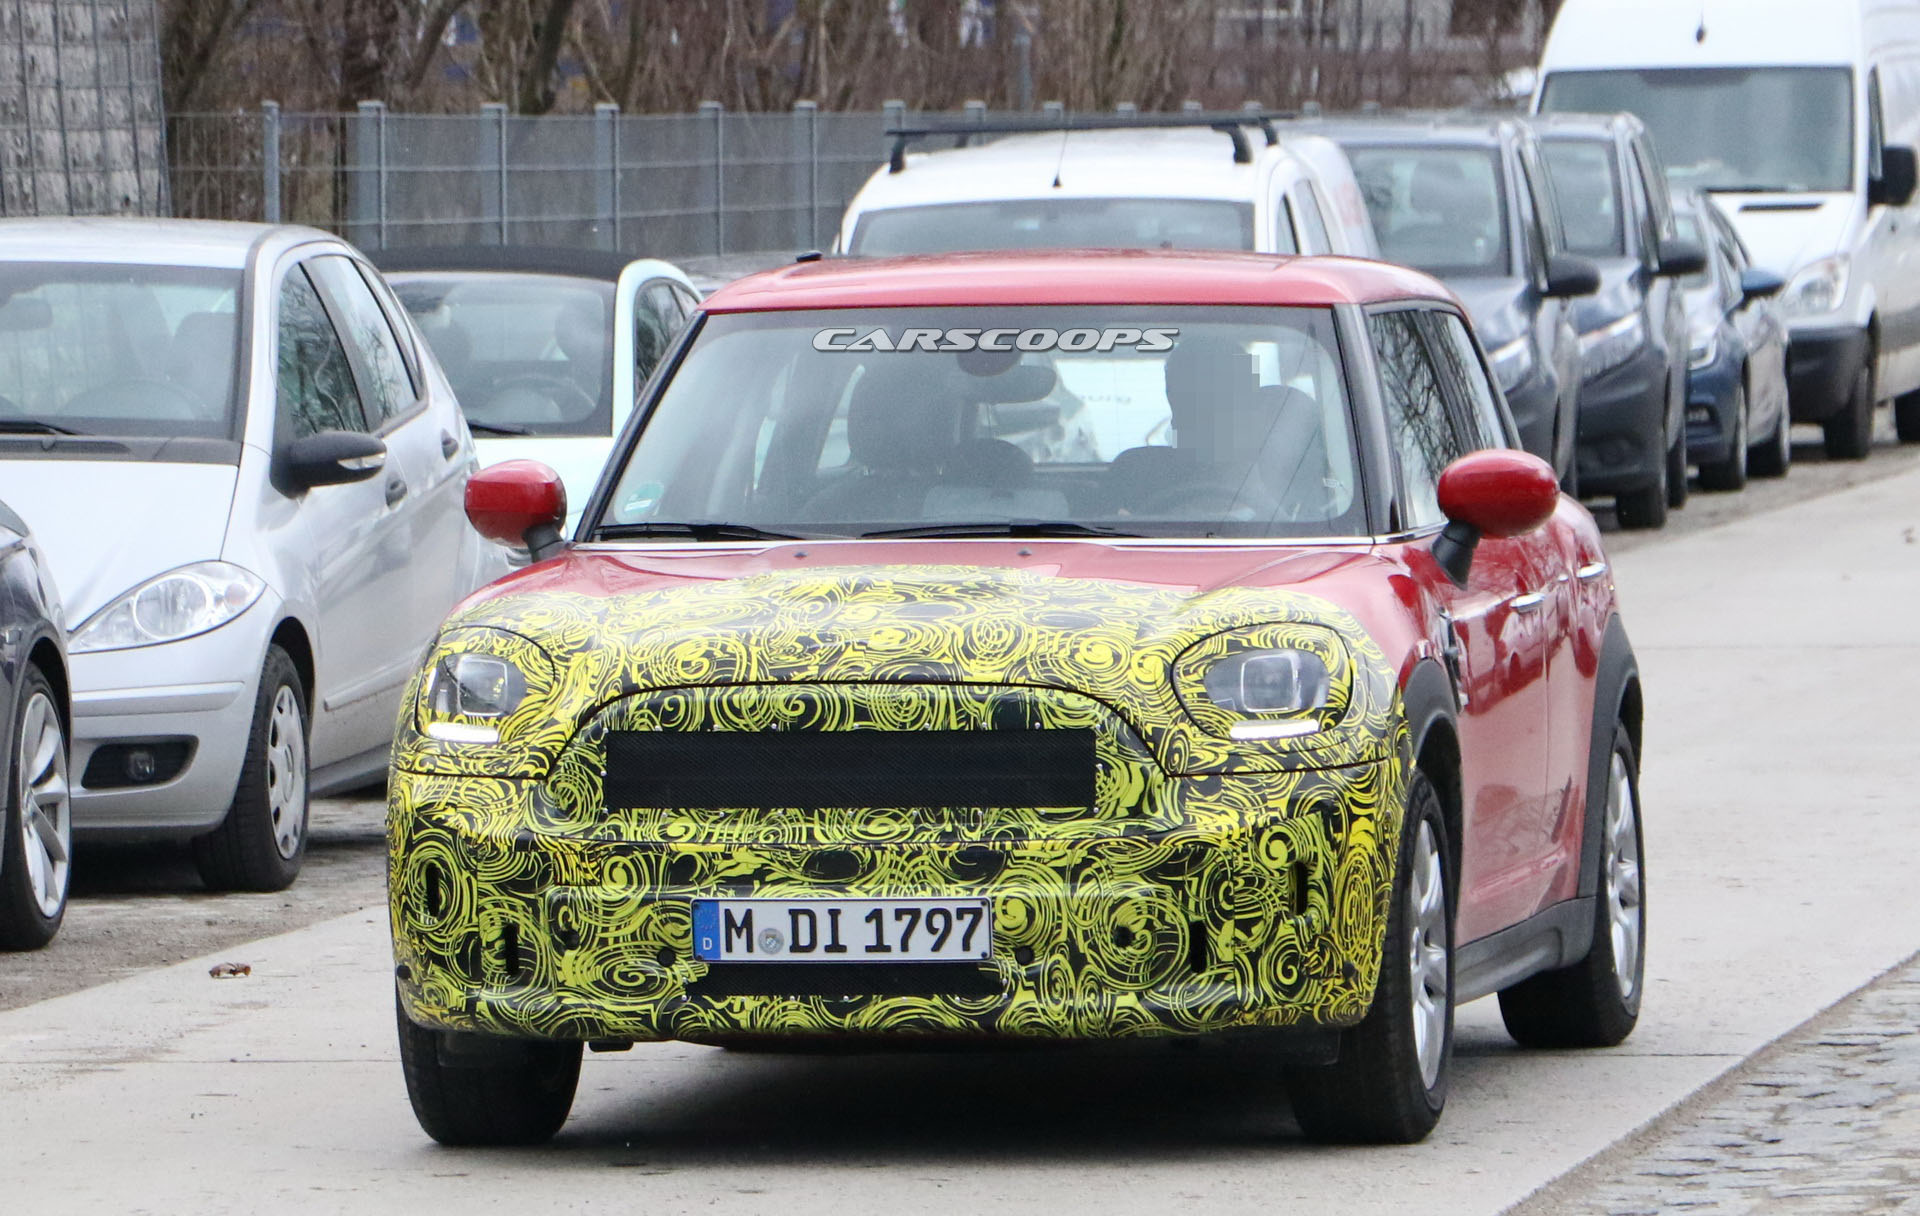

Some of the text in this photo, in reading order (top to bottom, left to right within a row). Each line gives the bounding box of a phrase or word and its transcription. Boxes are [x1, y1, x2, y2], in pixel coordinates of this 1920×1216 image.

[703, 907, 984, 953] D M DI 1797
